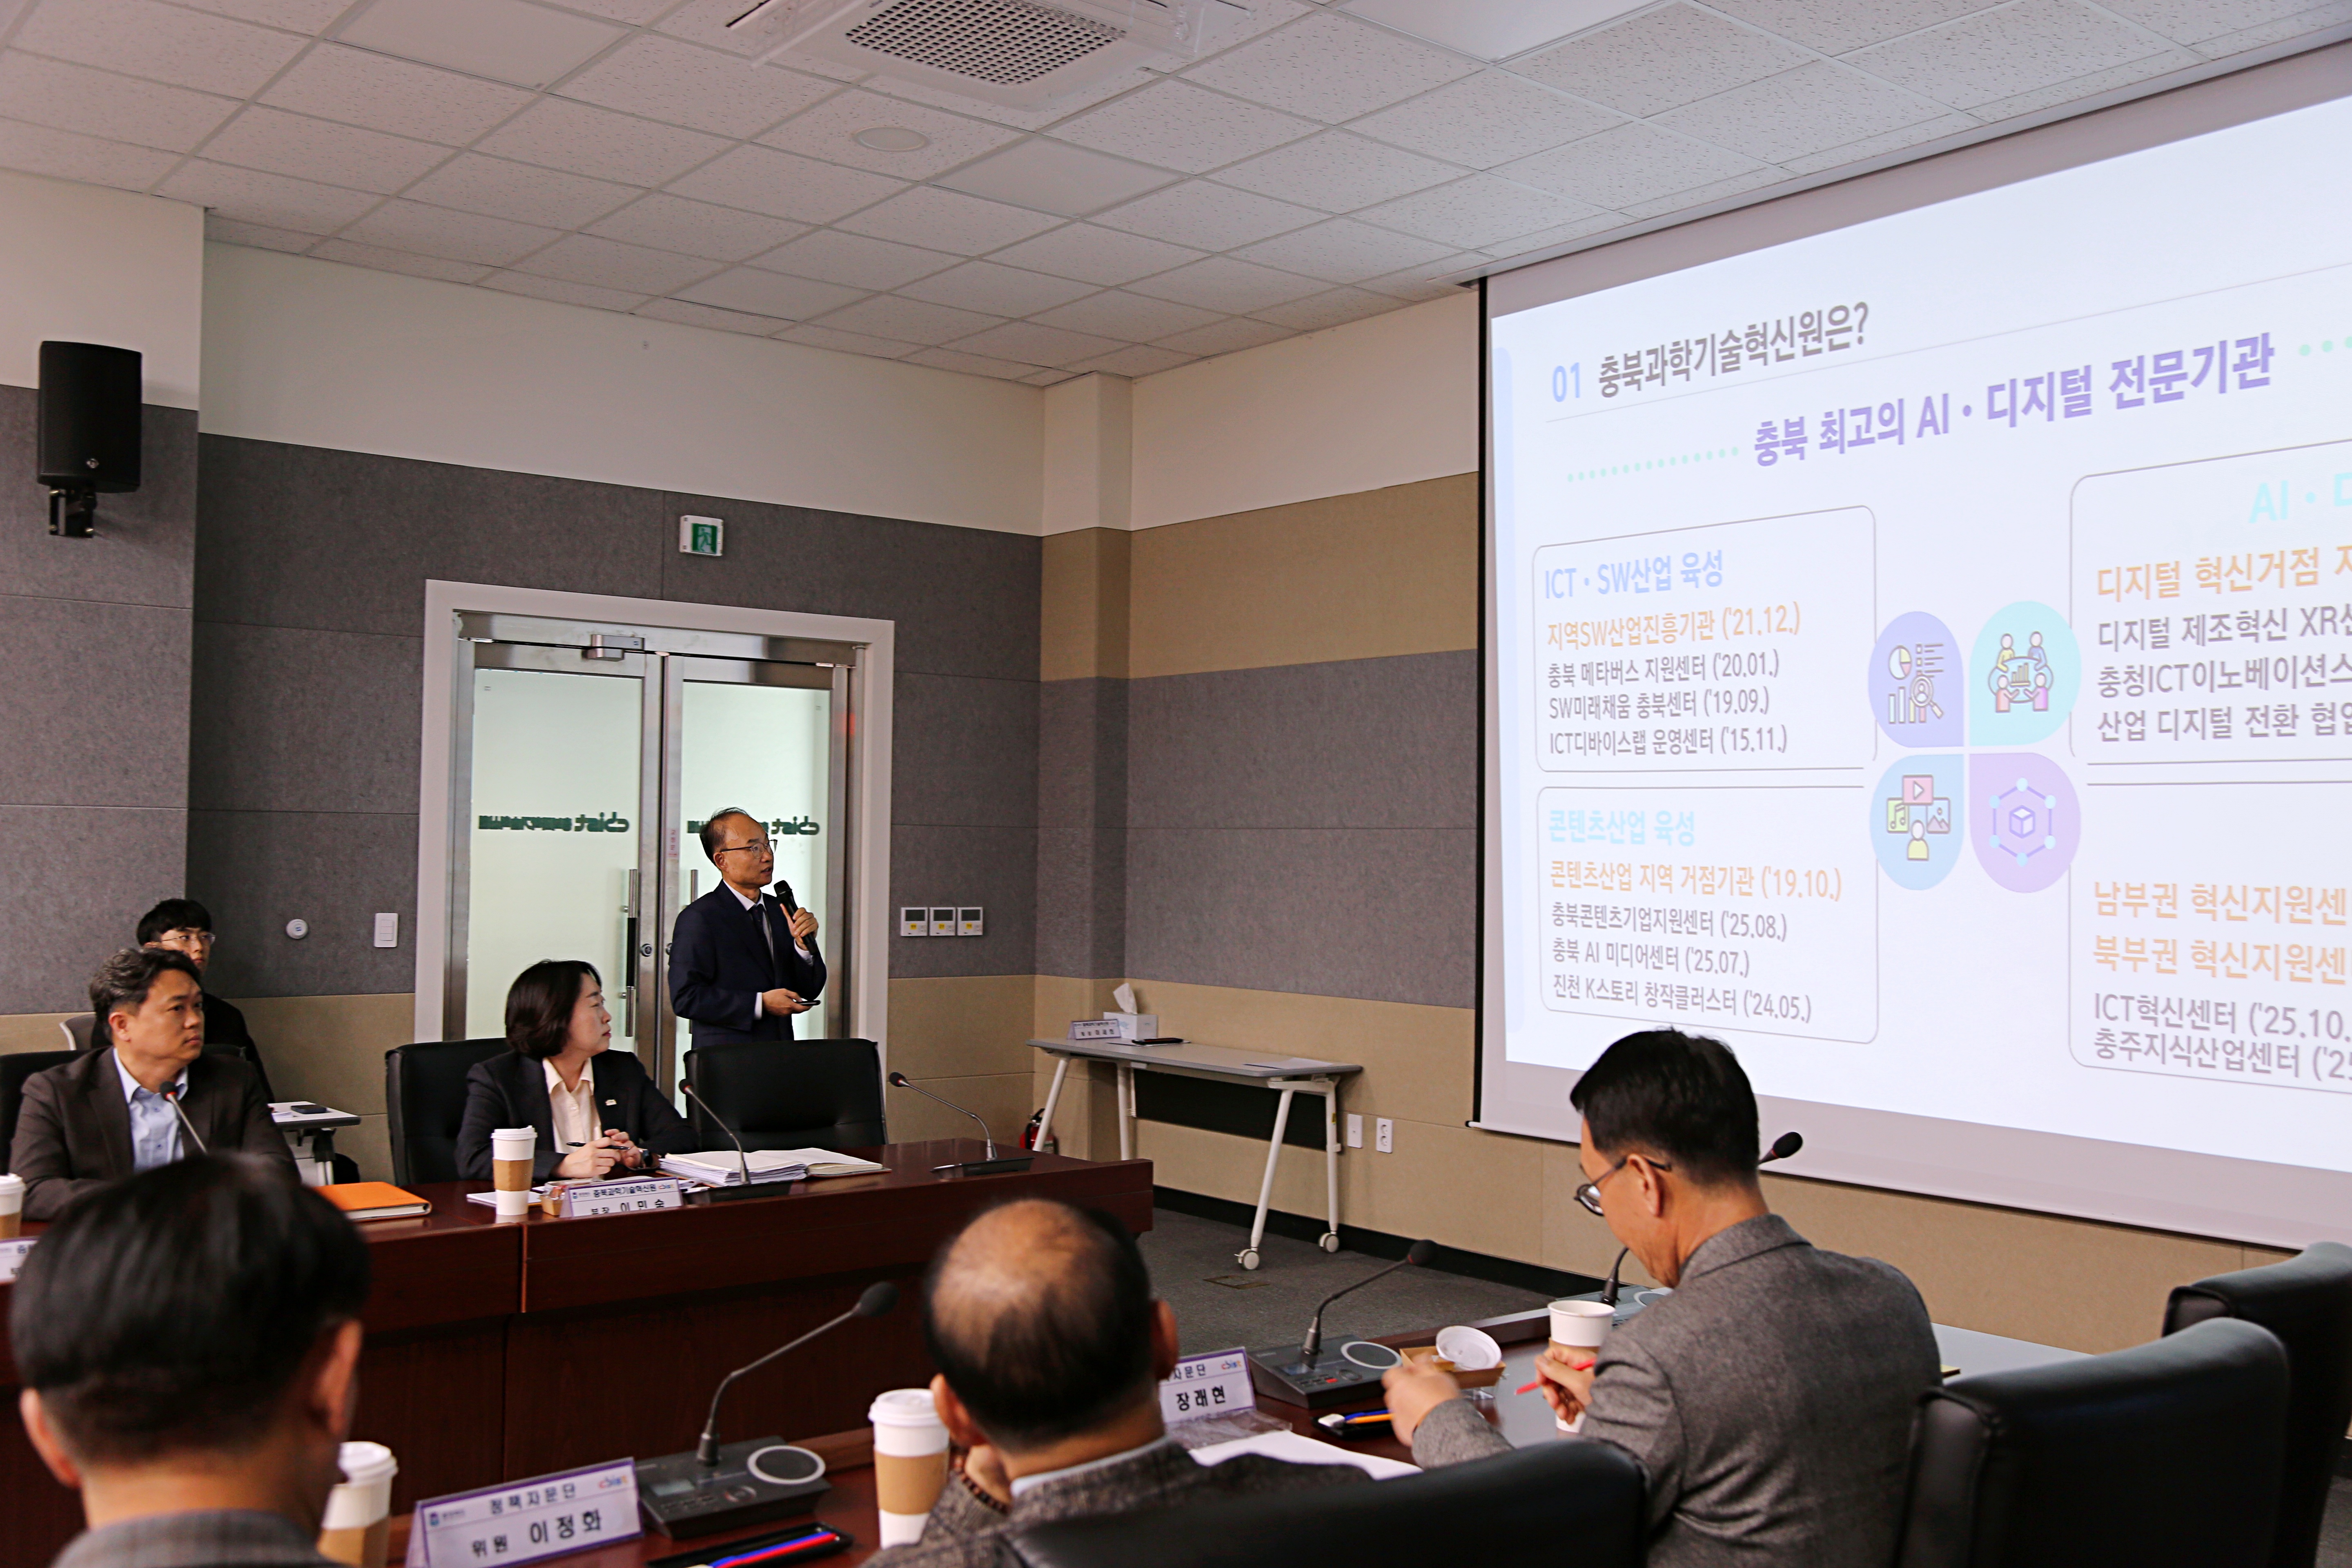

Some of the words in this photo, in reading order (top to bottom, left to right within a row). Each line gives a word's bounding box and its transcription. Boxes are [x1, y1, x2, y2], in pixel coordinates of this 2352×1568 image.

[1552, 362, 1581, 402] 01
[1599, 301, 1869, 399] 충북과학기술혁신원은?
[1755, 416, 1808, 466] 충북
[1820, 398, 1904, 454] 최고의
[1987, 365, 2092, 428] 디지털
[2109, 332, 2275, 410] 전문기관
[2249, 480, 2289, 523] AI
[1545, 568, 1577, 599] ICT
[1598, 555, 1671, 595] SW산업
[1680, 550, 1723, 588] 육성
[2098, 560, 2180, 602] 디지털
[2196, 546, 2319, 594] 혁신거점
[1548, 610, 1715, 650] 지역SW산업진흥기관
[1723, 601, 1800, 640] ('21.12.)
[2098, 617, 2170, 653] 디지털
[2181, 607, 2288, 647] 제조혁신
[1548, 664, 1575, 688] 충북
[1581, 659, 1639, 686] 메타버스
[1645, 654, 1706, 684] 지원센터
[1713, 648, 1779, 680] ('20.01.)
[2098, 653, 2352, 699] 충청ICT이노베이션스
[1550, 694, 1631, 721] SW미래채움
[1637, 690, 1697, 717] 충북센터
[1704, 686, 1769, 716] ('19.09.)
[2098, 710, 2146, 742] 산업
[2158, 706, 2232, 741] 디지털
[2245, 703, 2299, 738] 전환
[1550, 730, 1646, 756] ICT디바이스랩
[1653, 727, 1713, 755] 운영센터
[1721, 724, 1787, 754] ('15.11.)
[1549, 810, 1645, 845] 콘텐츠산업
[1654, 811, 1695, 846] 육성
[1551, 860, 1632, 892] 콘텐츠산업
[1640, 864, 1673, 894] 지역
[1681, 866, 1755, 897] 거점기관
[1762, 866, 1842, 902] ('19.10.)
[2095, 881, 2178, 919] 남부권
[1552, 902, 1714, 936] 충북콘텐츠기업지원센터
[1721, 911, 1787, 942] ('25.08.)
[1553, 938, 1579, 963] 충북
[1586, 941, 1599, 962] AI
[1606, 942, 1679, 972] 미디어센터
[1686, 946, 1750, 978] ('25.07.)
[2094, 935, 2178, 975] 북부권
[2190, 940, 2352, 985] 혁신지원센
[1554, 973, 1580, 1000] 진천
[1586, 978, 1638, 1006] K스토리
[1645, 982, 1736, 1016] 창작클러스터
[1744, 991, 1811, 1023] ('24.05.)
[2096, 993, 2236, 1033] ICT혁신센터
[2250, 1002, 2350, 1042] ('25.10.
[2094, 1028, 2299, 1078] 충주지식산업센터
[1174, 1364, 1205, 1380] 자문단
